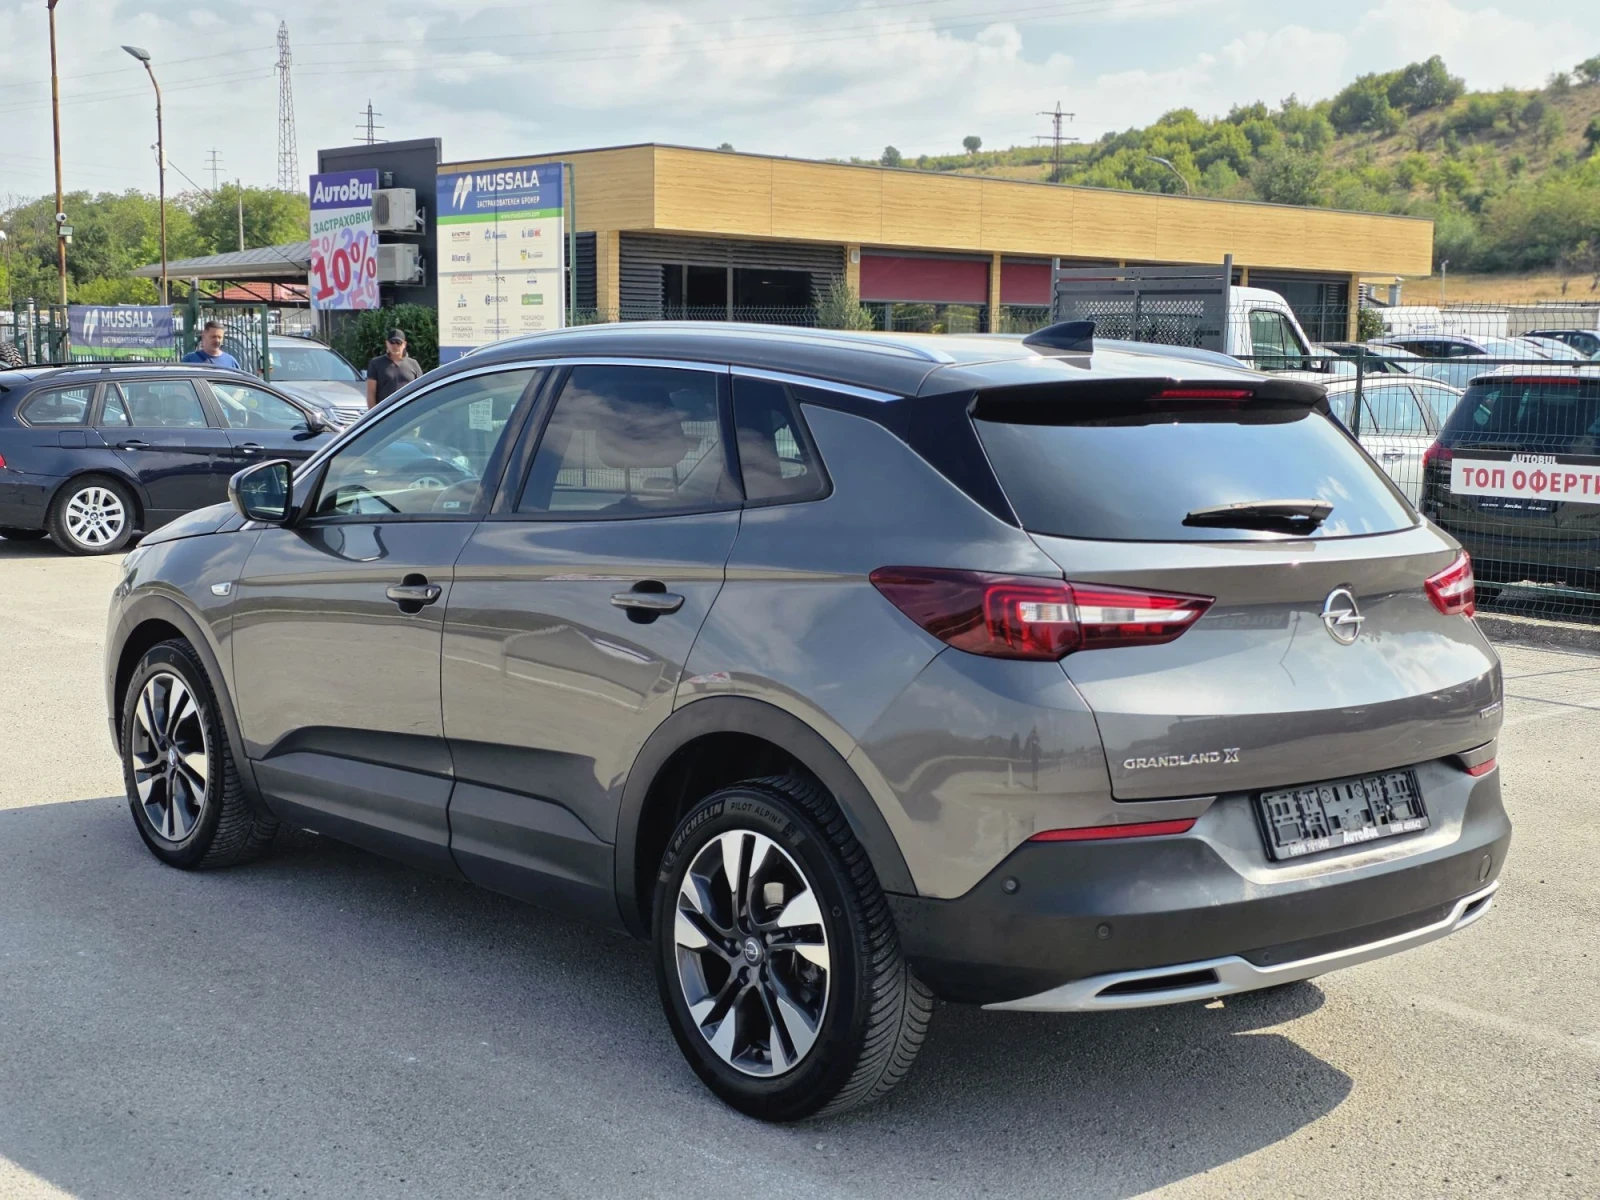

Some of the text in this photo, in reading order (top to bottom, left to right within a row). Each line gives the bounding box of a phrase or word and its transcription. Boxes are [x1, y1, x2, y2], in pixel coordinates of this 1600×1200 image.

[476, 169, 540, 192] MUSSALA
[313, 236, 377, 301] 10%
[101, 310, 154, 328] MUSSALA
[1510, 453, 1558, 464] AUTOBUL
[1462, 467, 1505, 489] ТОП
[1123, 747, 1241, 770] GRANDLAND X
[674, 802, 724, 850] MICHELIN
[730, 801, 753, 811] PILOT
